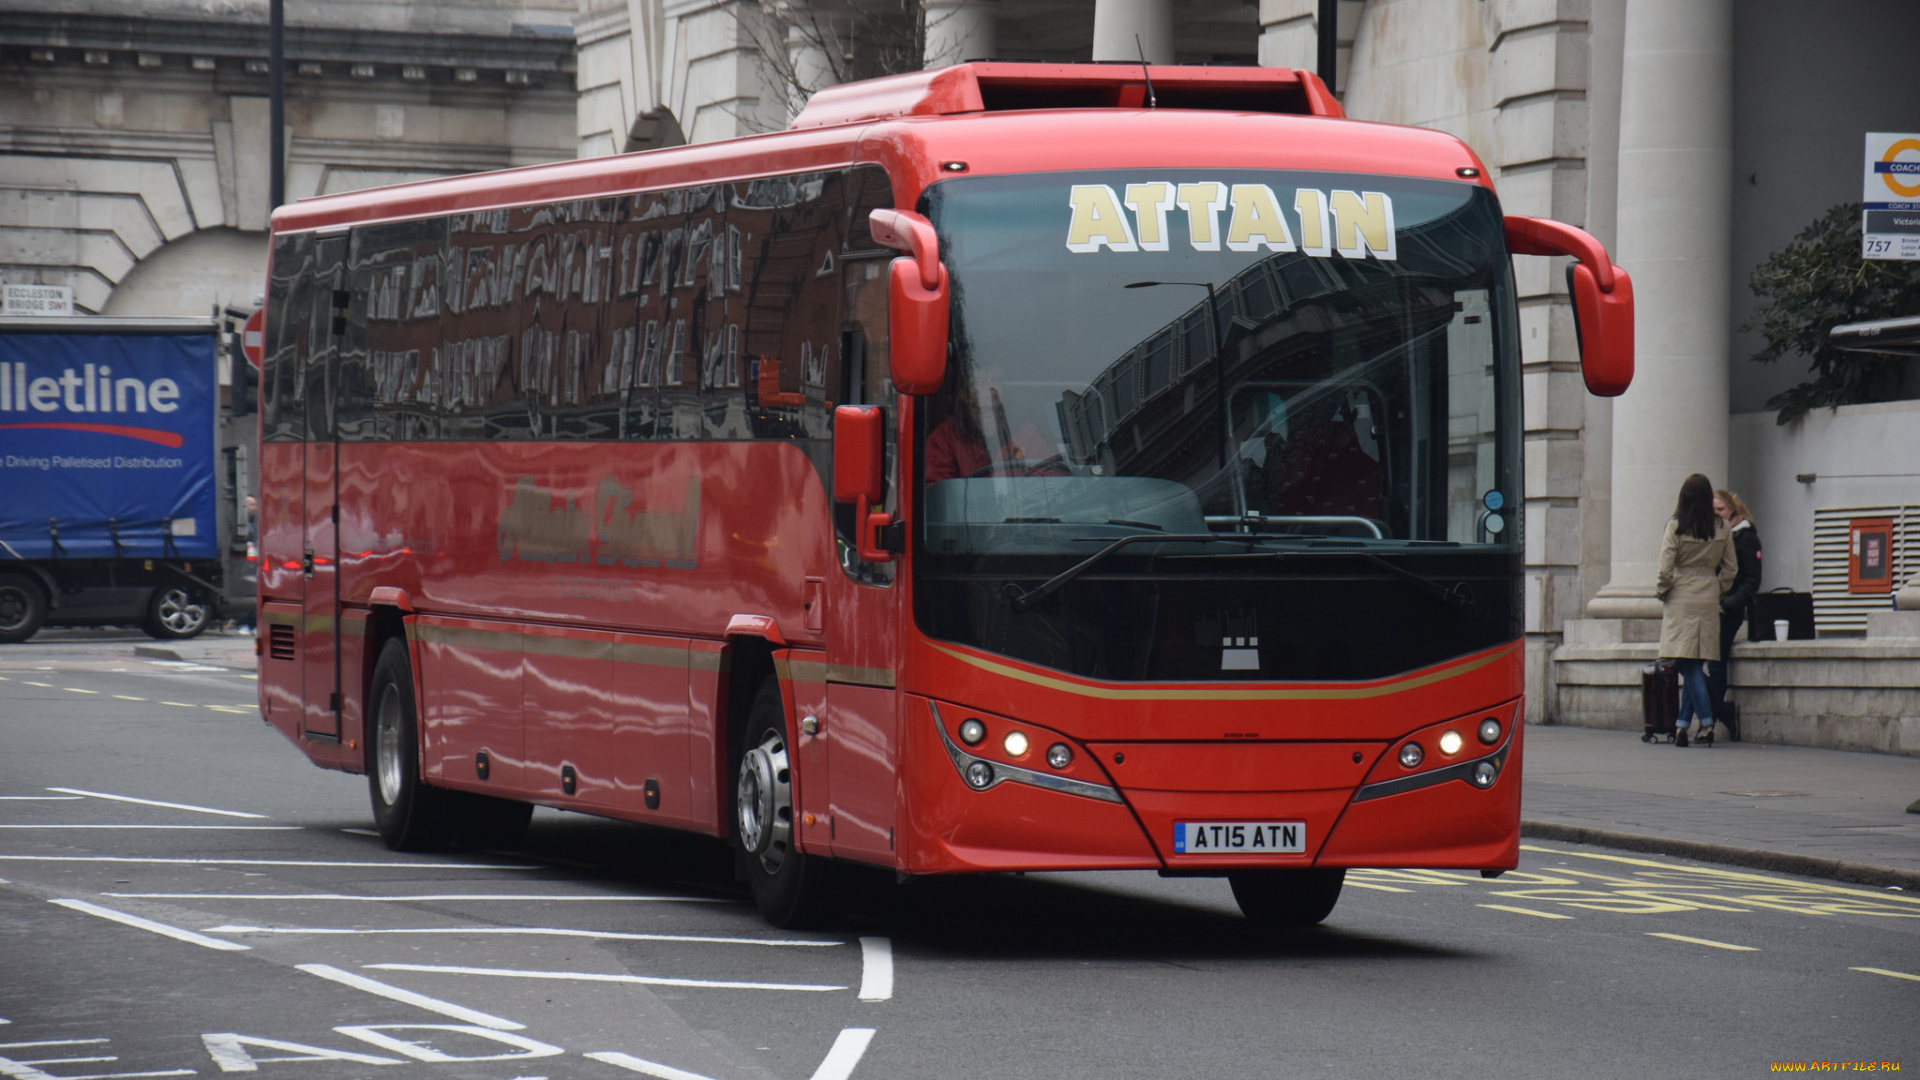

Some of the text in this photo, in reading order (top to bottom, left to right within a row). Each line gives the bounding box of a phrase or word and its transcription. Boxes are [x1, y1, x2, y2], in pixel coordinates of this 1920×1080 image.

[1889, 163, 1920, 172] COACH
[1066, 181, 1397, 260] ATTAIN
[1867, 241, 1891, 252] 757
[8, 287, 63, 299] ECCLESTON
[8, 299, 67, 310] BRIDGE SW1
[6, 455, 49, 470] Driving
[52, 455, 111, 469] Palletised
[114, 456, 182, 469] Distribution
[1194, 826, 1296, 847] AT15 ATN
